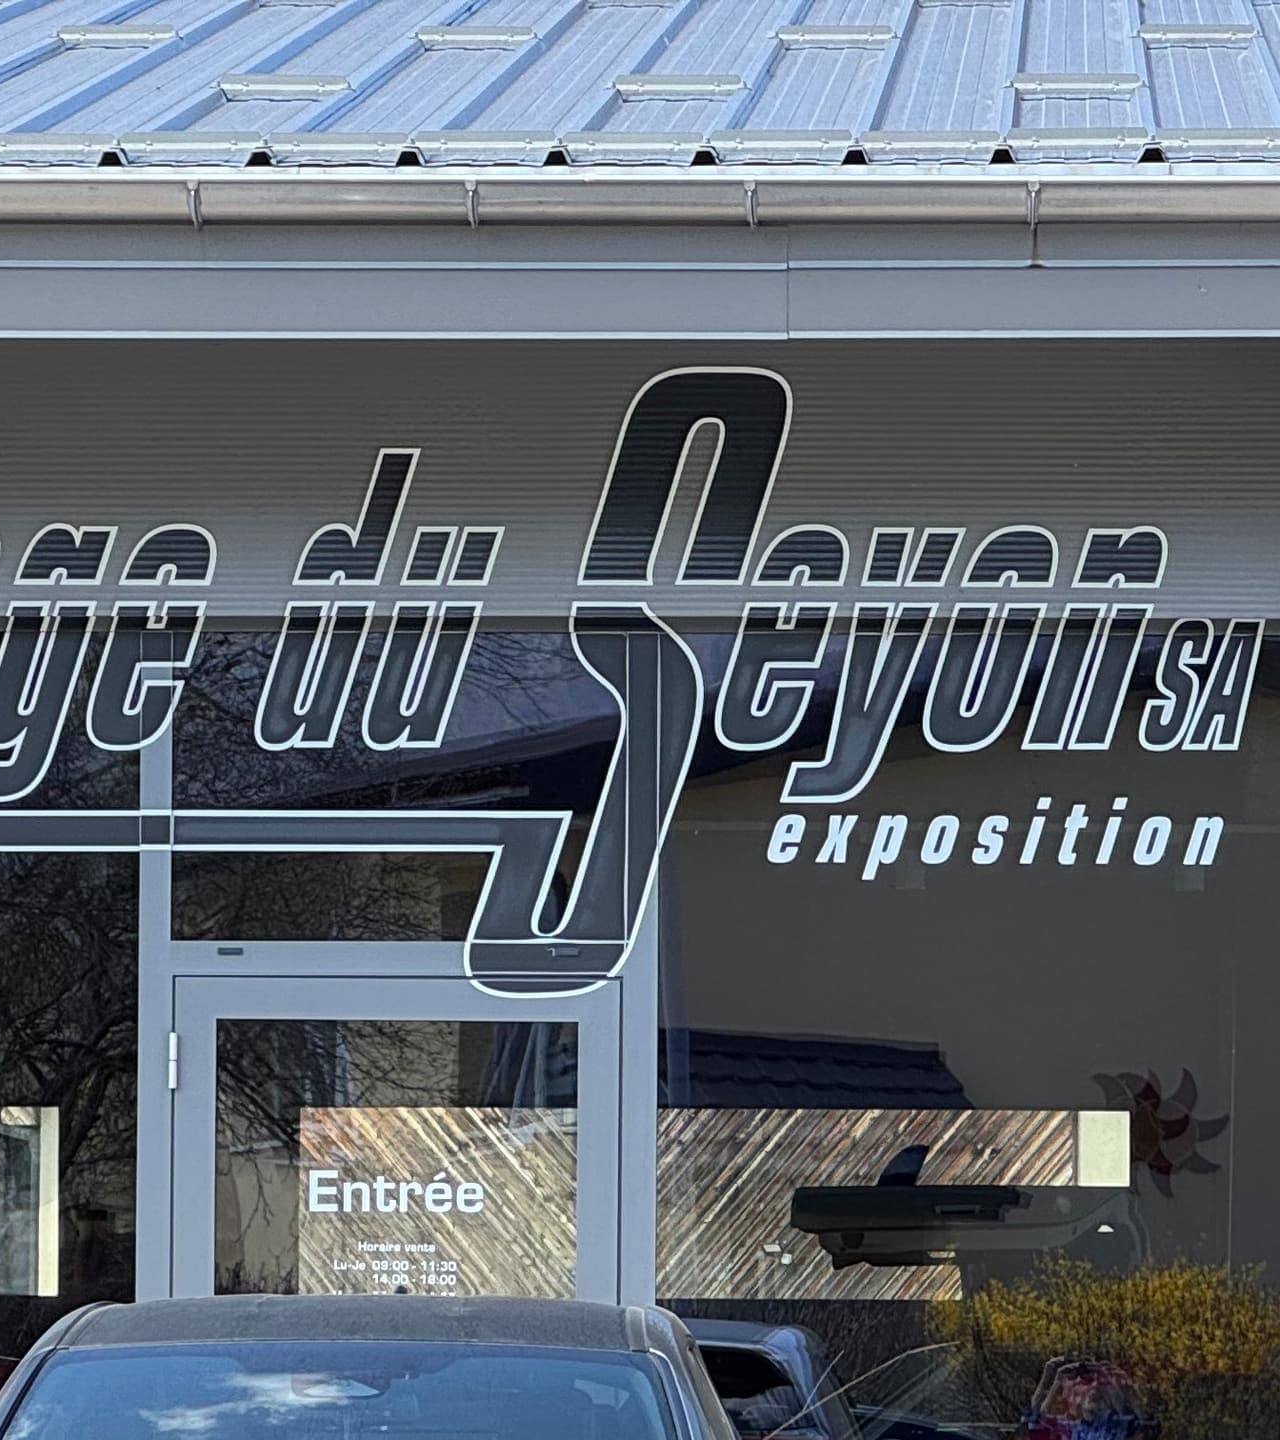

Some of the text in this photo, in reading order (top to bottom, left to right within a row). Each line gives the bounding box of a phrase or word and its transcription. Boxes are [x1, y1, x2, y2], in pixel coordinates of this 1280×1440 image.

[254, 448, 505, 751] du
[1138, 617, 1265, 752] SA
[766, 797, 1224, 880] exposition
[308, 1170, 484, 1213] Entrée
[358, 1241, 436, 1253] Horaire vente
[420, 1260, 457, 1272] 11:30
